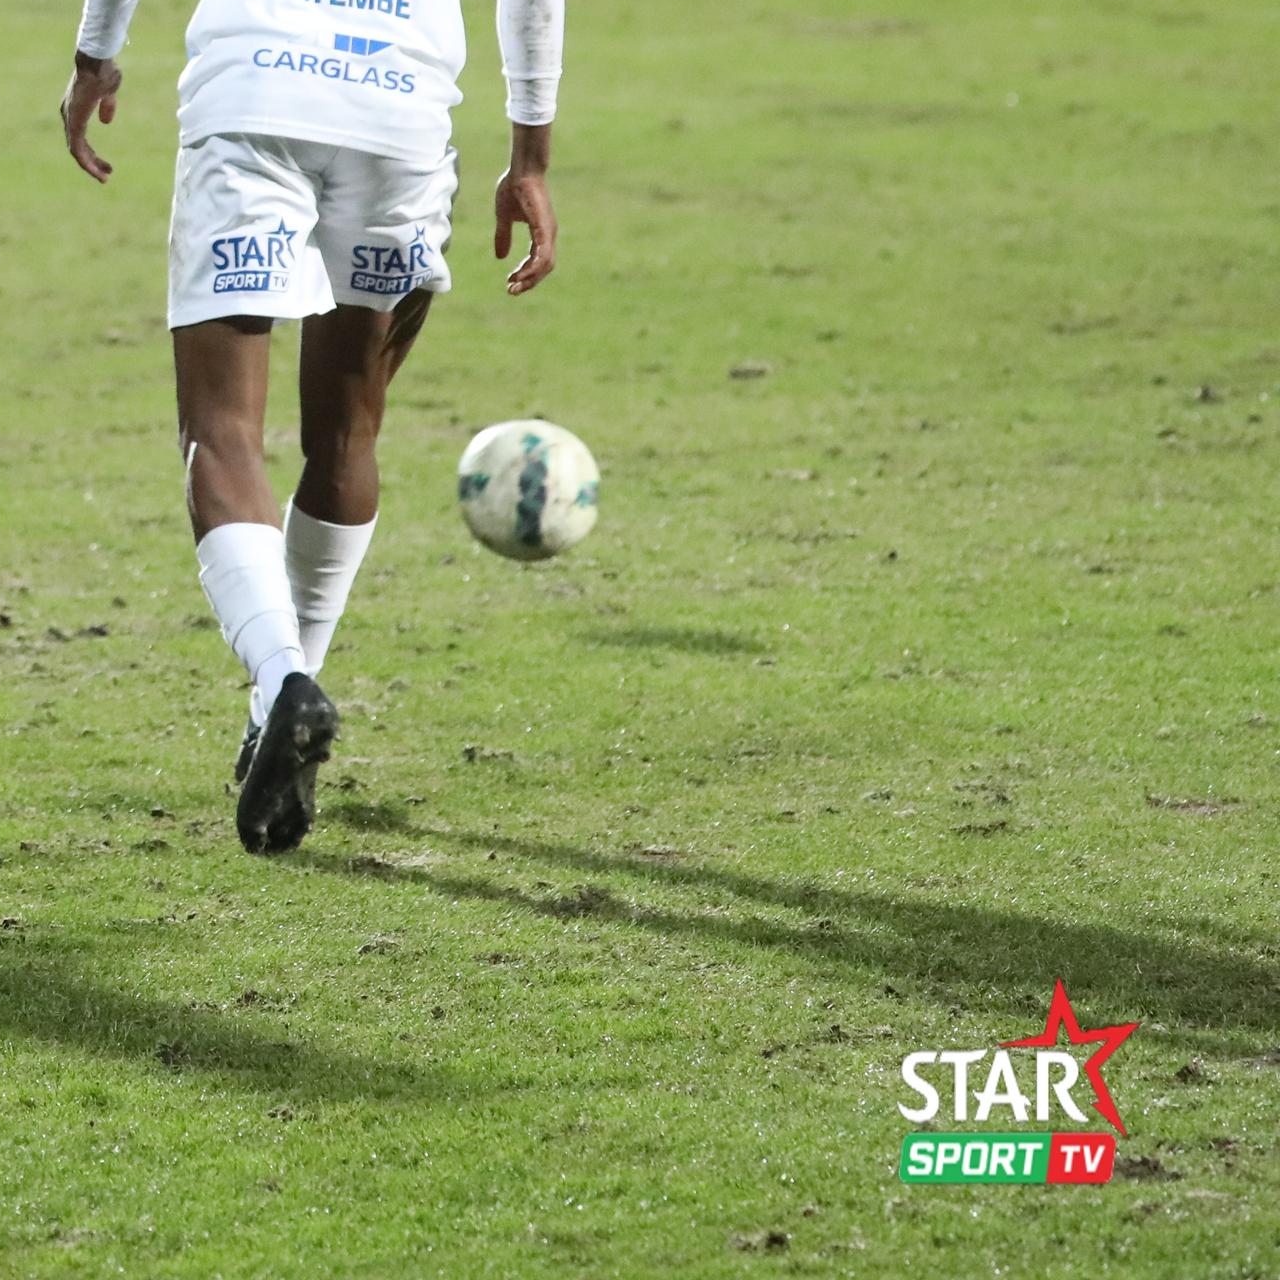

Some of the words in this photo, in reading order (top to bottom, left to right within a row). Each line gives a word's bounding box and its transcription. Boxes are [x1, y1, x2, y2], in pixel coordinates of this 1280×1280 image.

[252, 48, 416, 94] CARGLASS
[211, 235, 288, 271] STAR
[351, 242, 429, 273] STAR
[215, 273, 268, 292] SPORT
[271, 275, 289, 290] TV
[353, 273, 409, 293] SPORT
